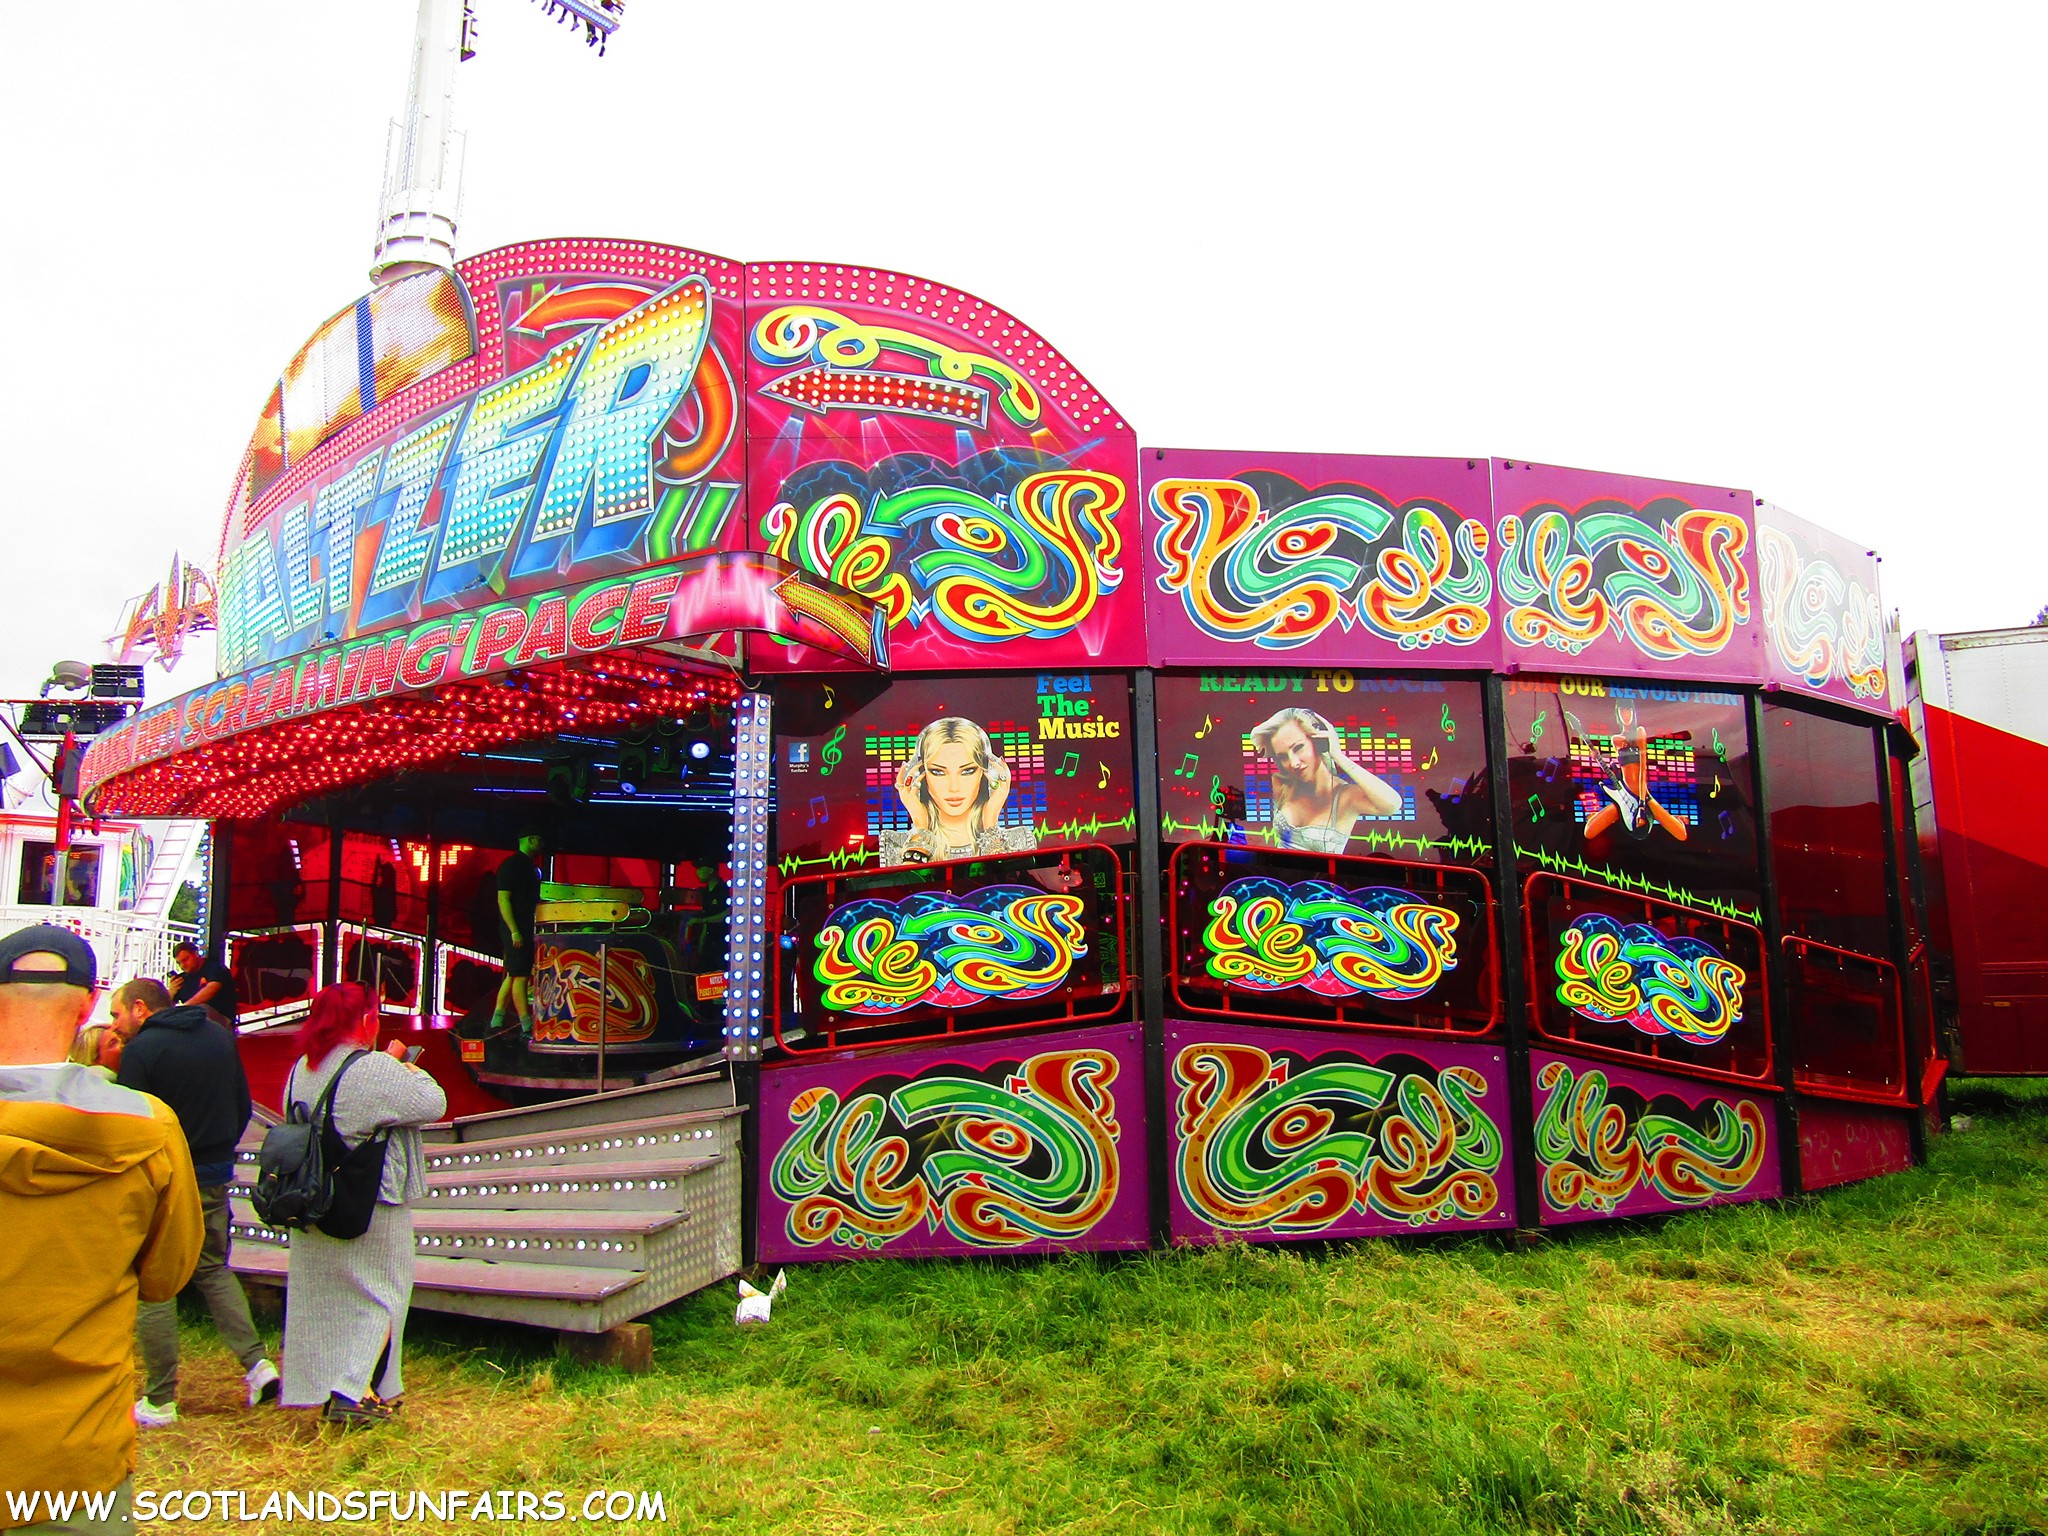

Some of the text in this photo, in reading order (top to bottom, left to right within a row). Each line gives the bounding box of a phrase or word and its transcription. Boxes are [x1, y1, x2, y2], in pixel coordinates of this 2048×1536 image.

[1036, 671, 1092, 694] Feel
[1199, 669, 1446, 693] READY TO ROCK
[1509, 674, 1739, 706] JOIN OUR REVOLUTION
[1037, 694, 1090, 717] The
[1037, 715, 1120, 740] Music
